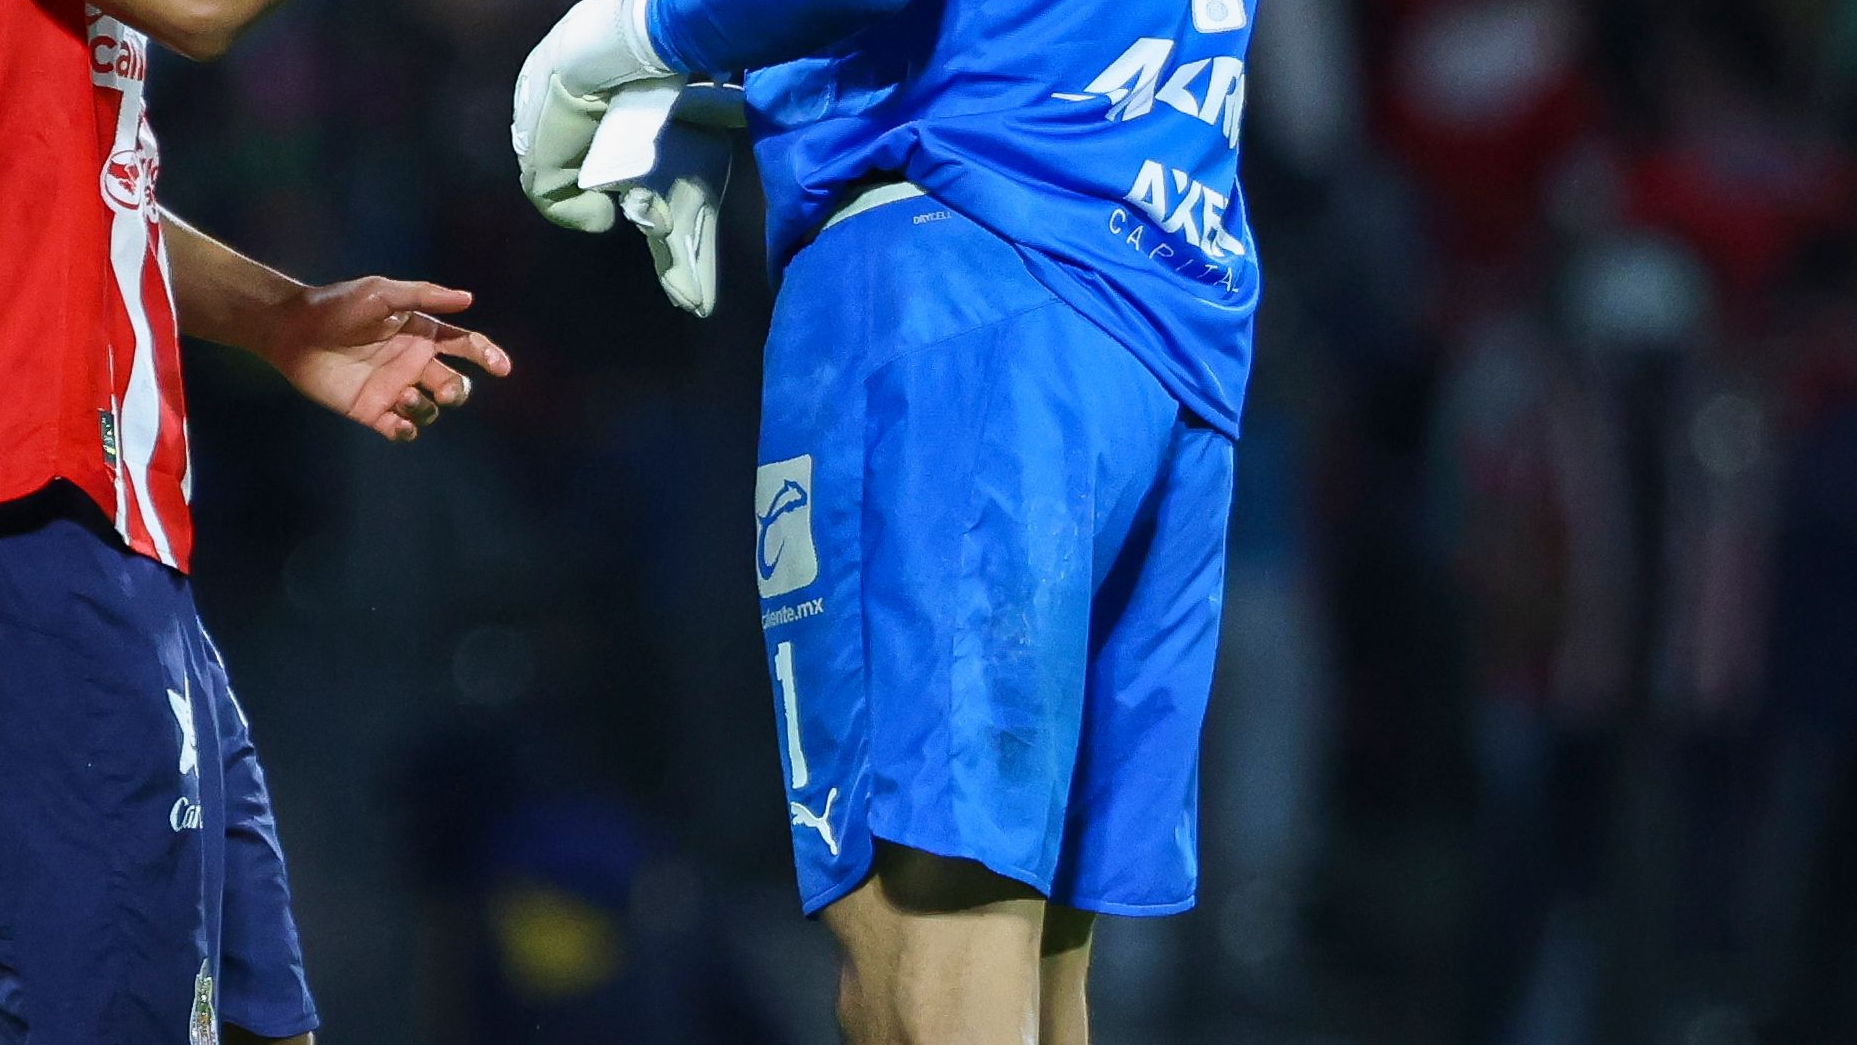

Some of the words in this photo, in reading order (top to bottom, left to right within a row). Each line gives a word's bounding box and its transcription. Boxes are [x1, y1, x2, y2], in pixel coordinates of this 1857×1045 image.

[1051, 37, 1245, 150] AKR
[1109, 208, 1239, 293] CAPITA
[774, 640, 809, 790] 1
